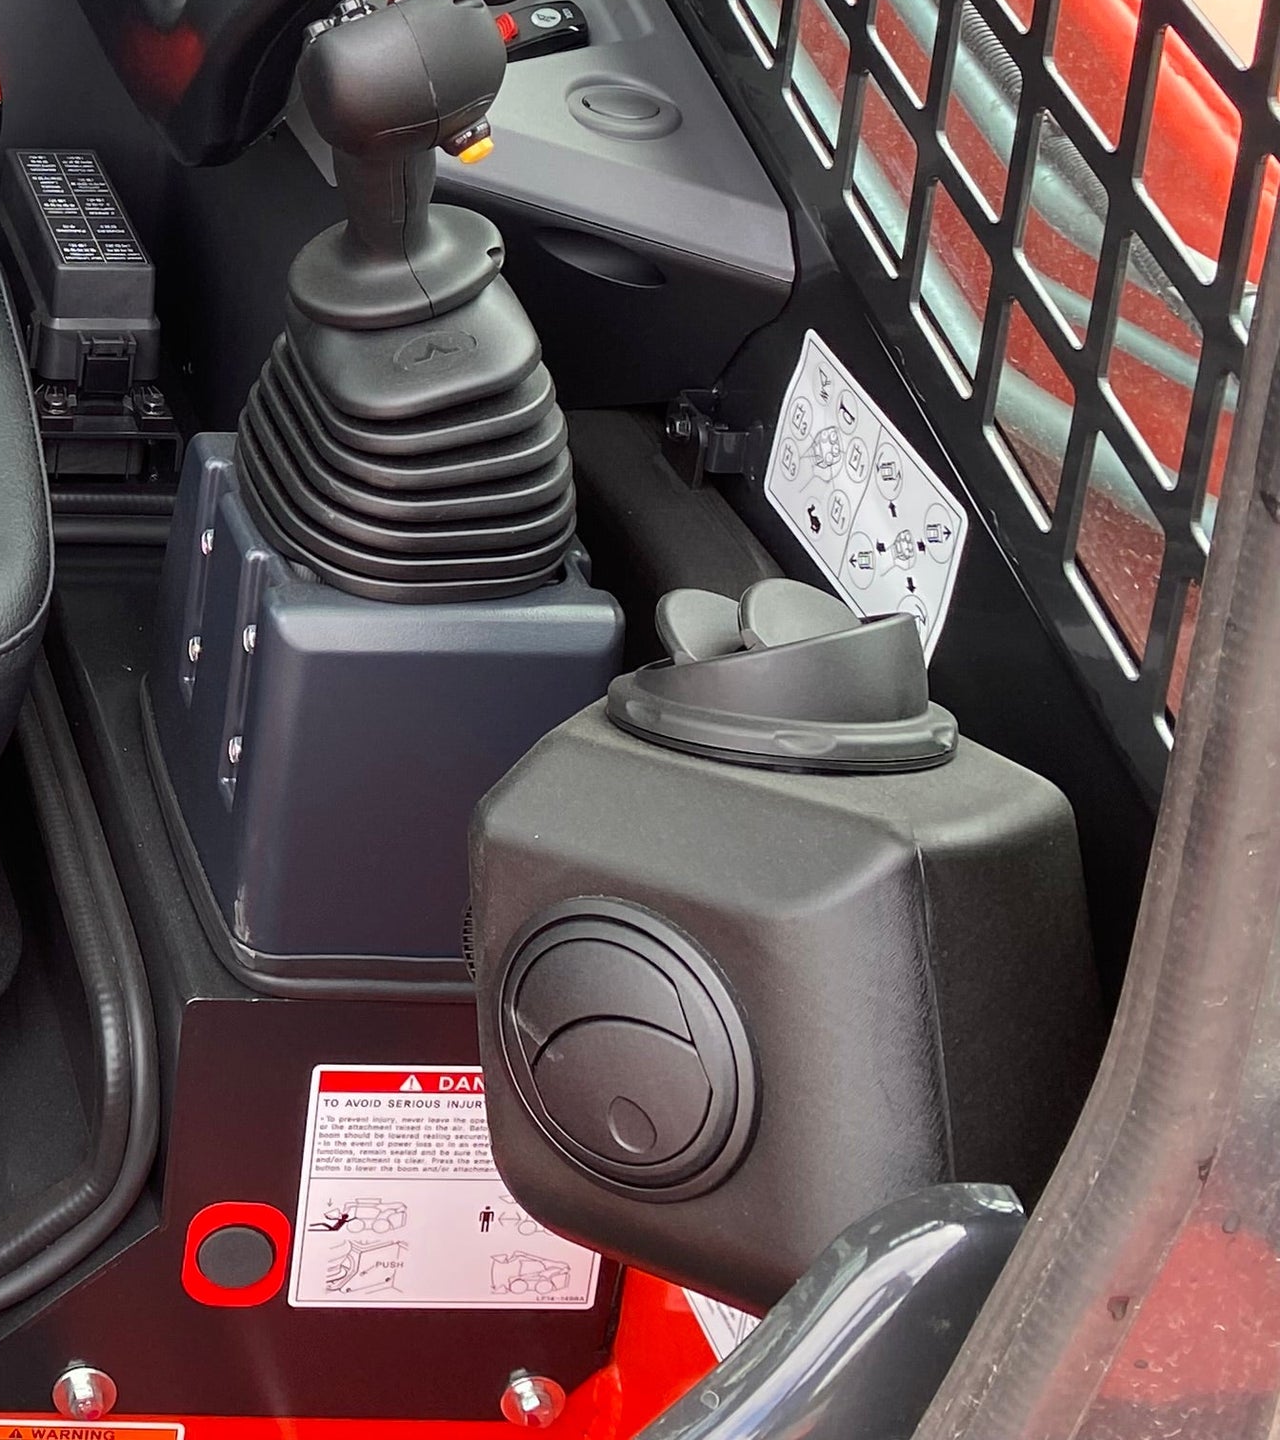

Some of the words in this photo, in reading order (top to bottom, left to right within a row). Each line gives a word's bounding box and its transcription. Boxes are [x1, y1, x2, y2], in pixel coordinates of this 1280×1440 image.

[438, 1076, 485, 1091] DAN
[323, 1098, 339, 1108] TO
[345, 1098, 382, 1108] AVOID
[387, 1099, 441, 1109] SERIOUS
[447, 1100, 486, 1109] INJUR
[375, 1261, 404, 1269] PUSH
[31, 1428, 115, 1440] WARNING
